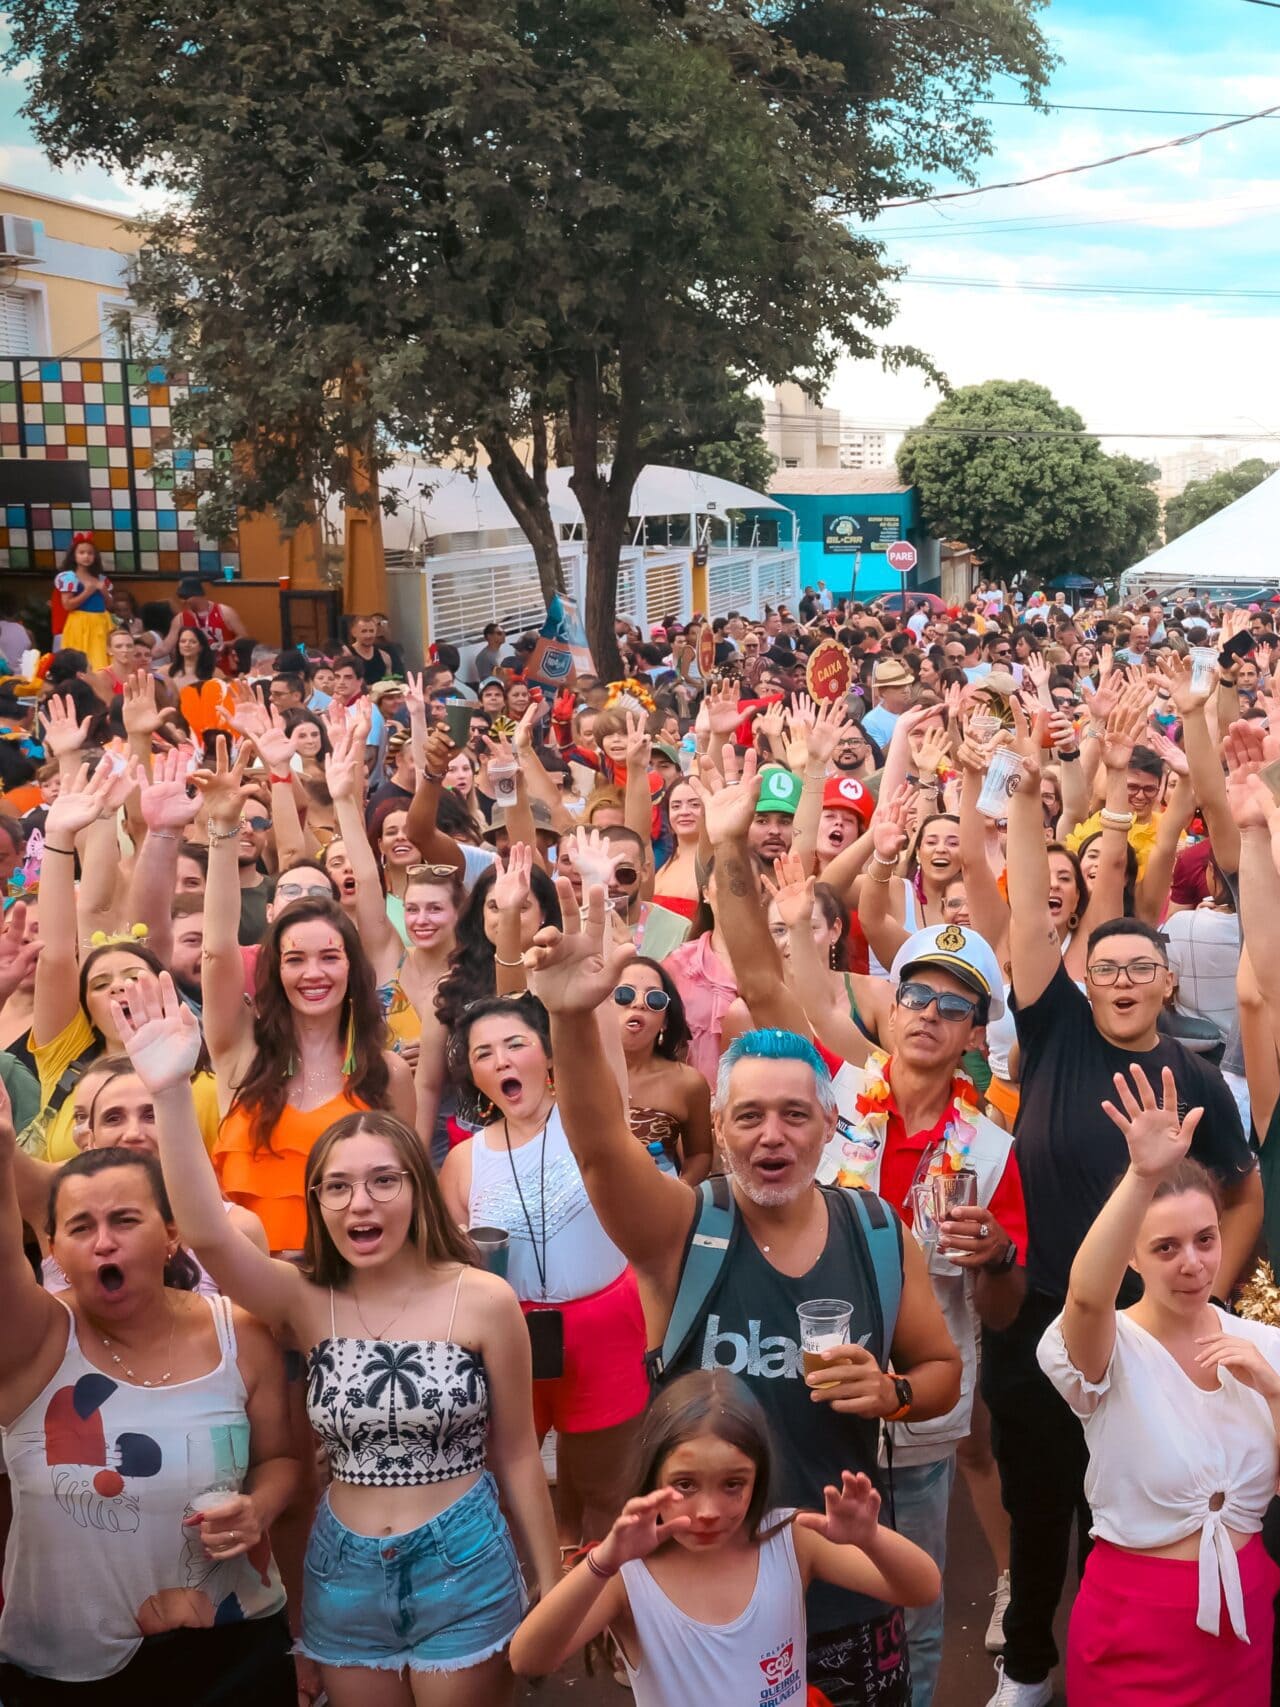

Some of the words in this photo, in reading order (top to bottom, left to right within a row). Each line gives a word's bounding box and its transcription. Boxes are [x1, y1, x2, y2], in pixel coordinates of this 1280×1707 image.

[889, 551, 913, 561] PARE
[817, 660, 842, 682] CAIXA
[776, 775, 786, 791] L
[843, 782, 858, 794] M
[760, 1669, 801, 1698] QUEIROZ
